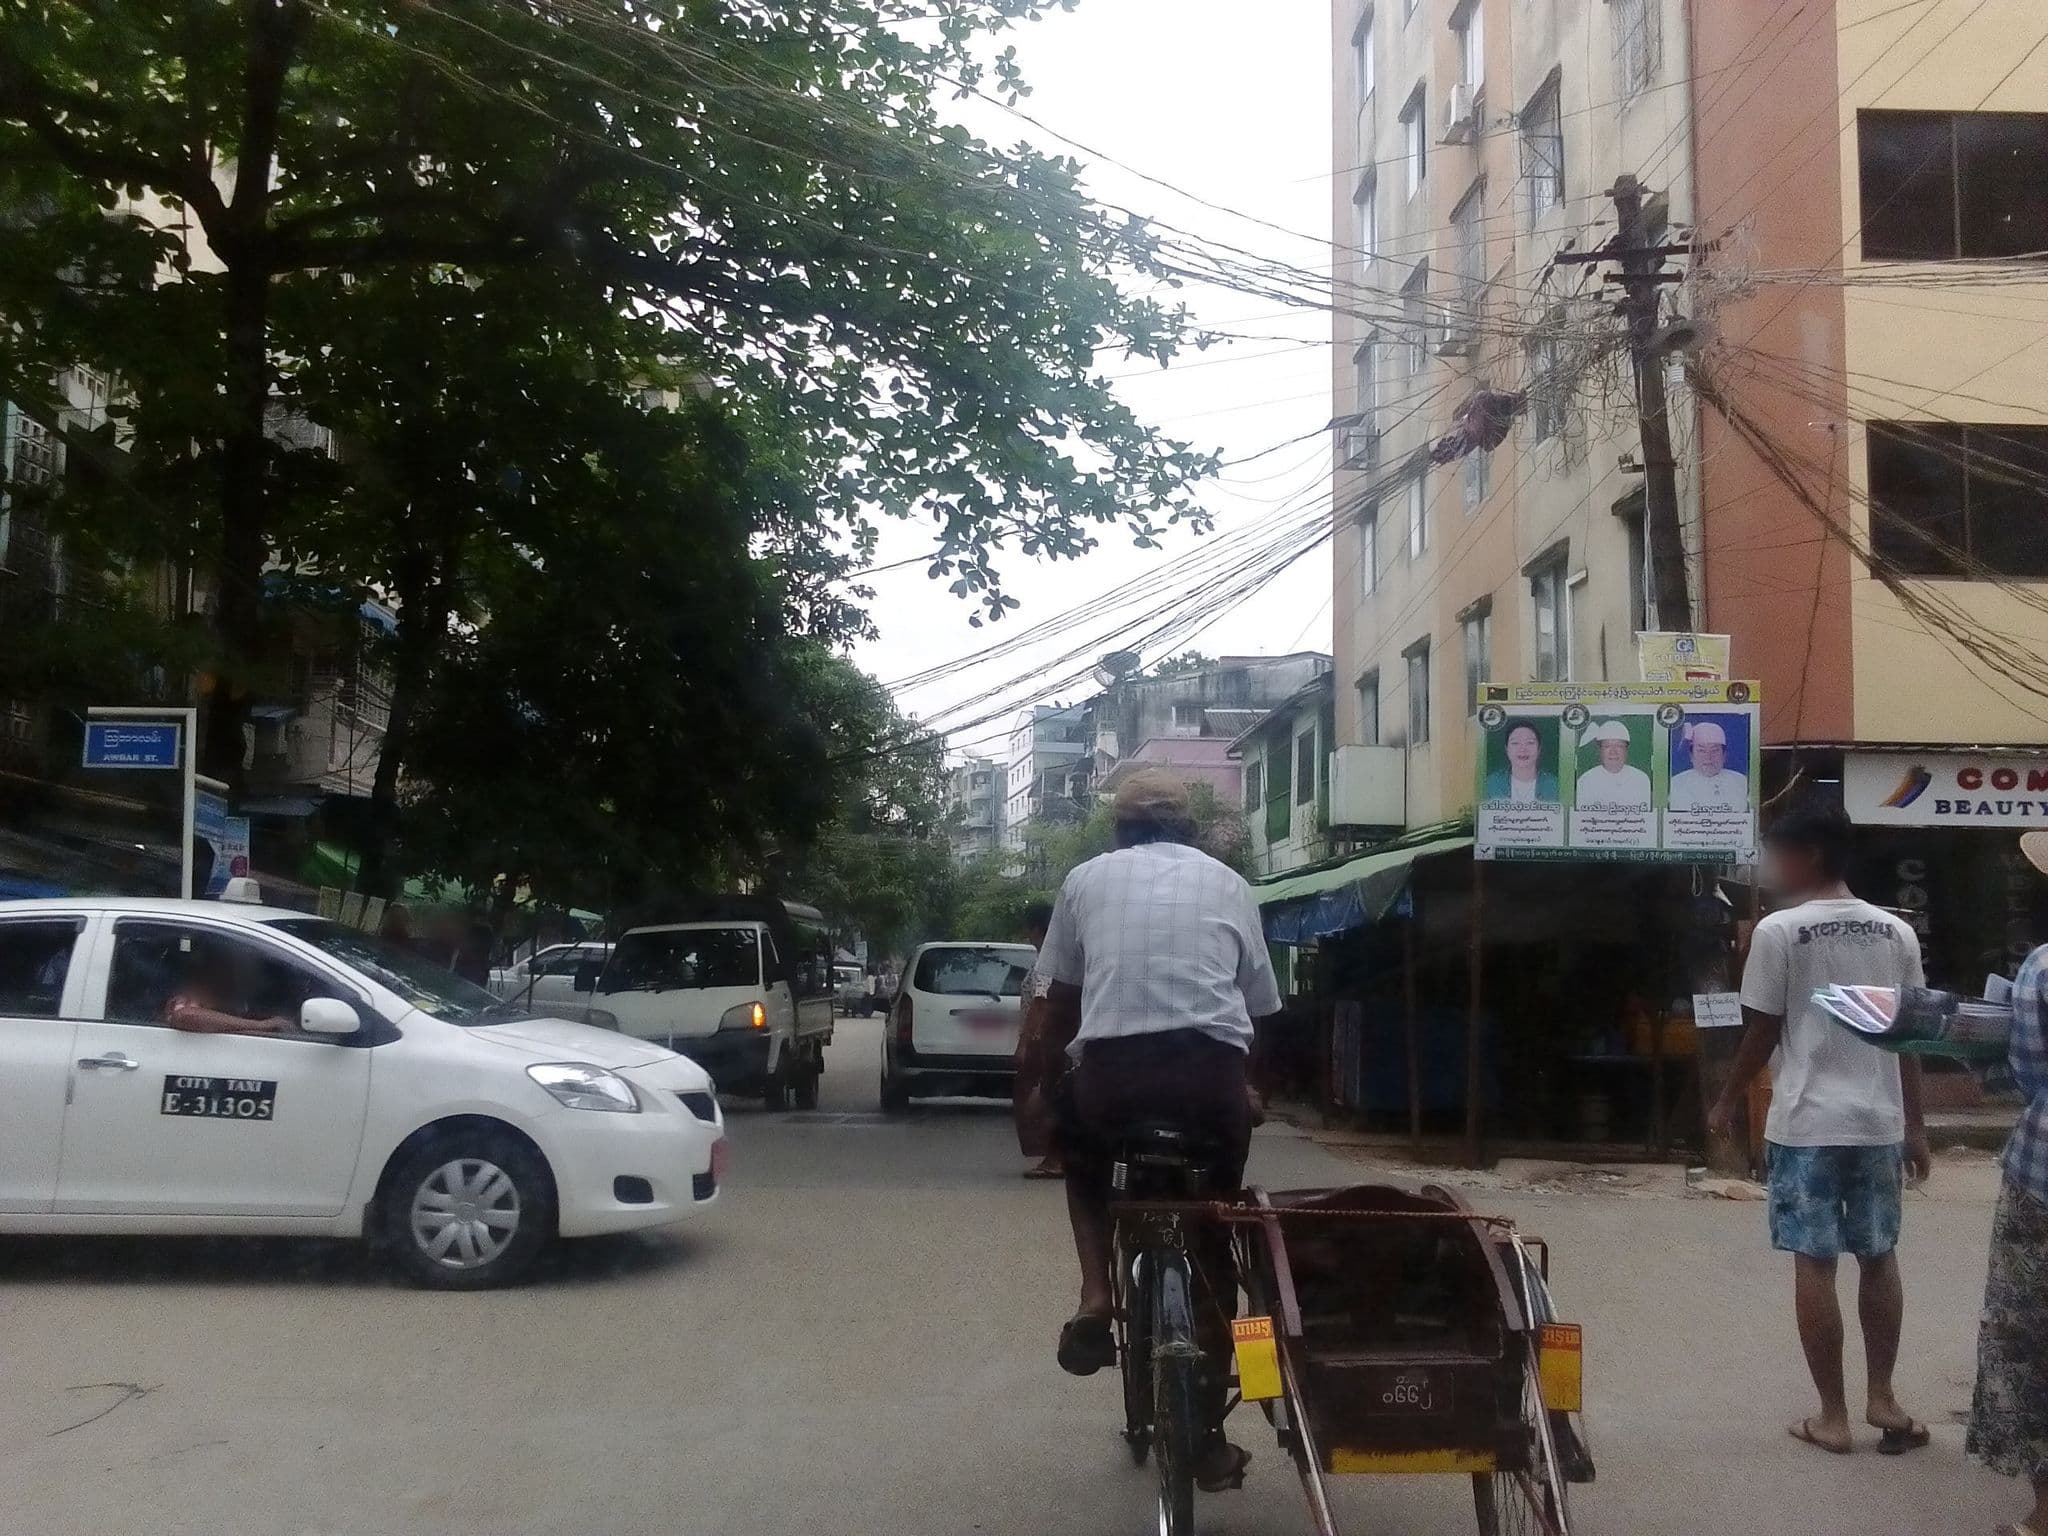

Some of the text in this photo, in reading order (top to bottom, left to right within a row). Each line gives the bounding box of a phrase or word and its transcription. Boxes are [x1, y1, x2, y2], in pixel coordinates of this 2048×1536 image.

[176, 1076, 263, 1093] CITY TAXI
[164, 1092, 272, 1118] E-31305
